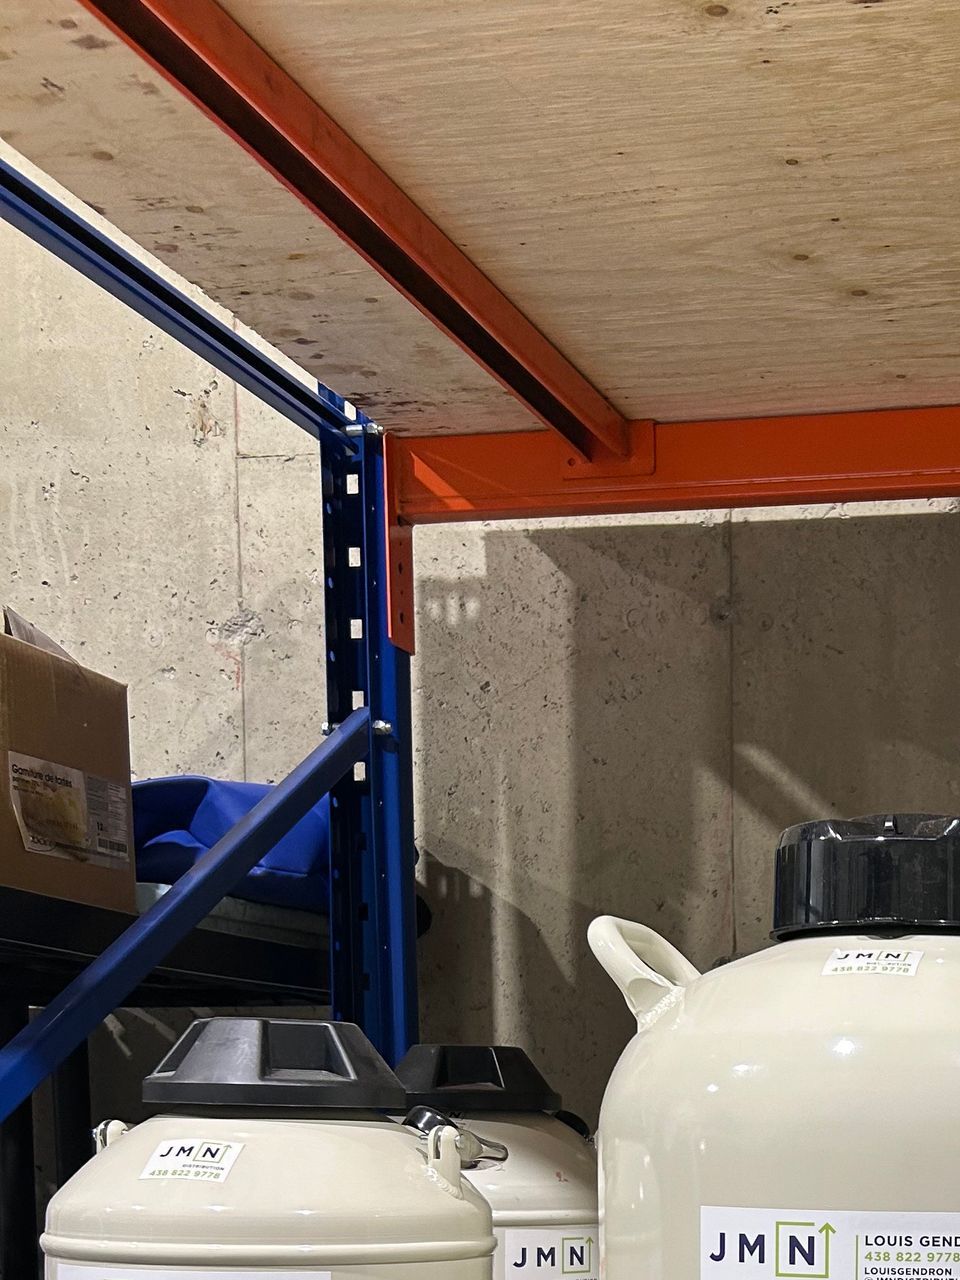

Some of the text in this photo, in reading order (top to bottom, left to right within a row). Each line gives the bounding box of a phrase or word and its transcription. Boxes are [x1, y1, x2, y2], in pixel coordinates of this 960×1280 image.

[194, 1171, 221, 1179] 9778
[865, 1235, 913, 1247] LOUIS
[864, 1252, 960, 1263] 438 822 9778
[864, 1267, 952, 1276] LOUISGENDRON
